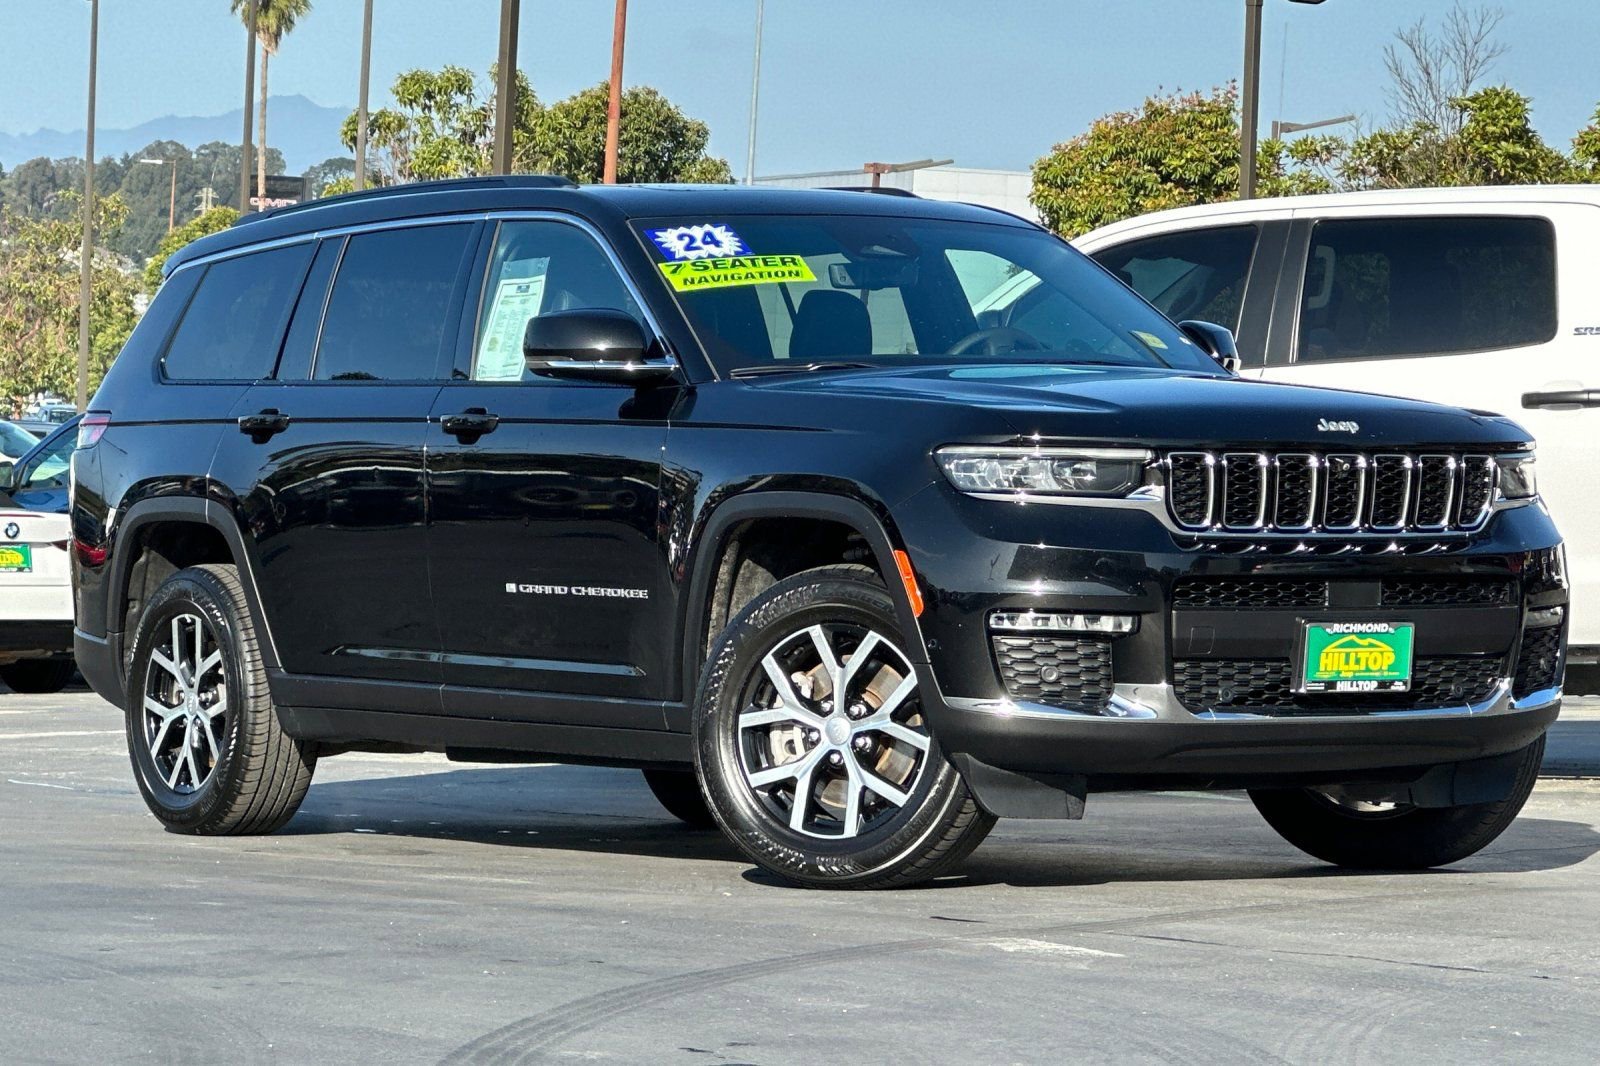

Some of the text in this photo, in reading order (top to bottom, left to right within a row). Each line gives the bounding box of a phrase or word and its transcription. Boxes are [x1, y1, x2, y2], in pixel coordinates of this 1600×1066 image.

[676, 230, 723, 251] 24
[665, 256, 798, 275] 7 SEATER
[683, 269, 800, 286] NAVIGATION
[1317, 418, 1359, 434] Jeep
[519, 584, 568, 595] GRAND
[571, 586, 649, 599] CHEROKEE
[1333, 623, 1389, 633] RICHMOND
[1319, 651, 1396, 671] HILLTOP
[1336, 681, 1379, 691] HILLTOP
